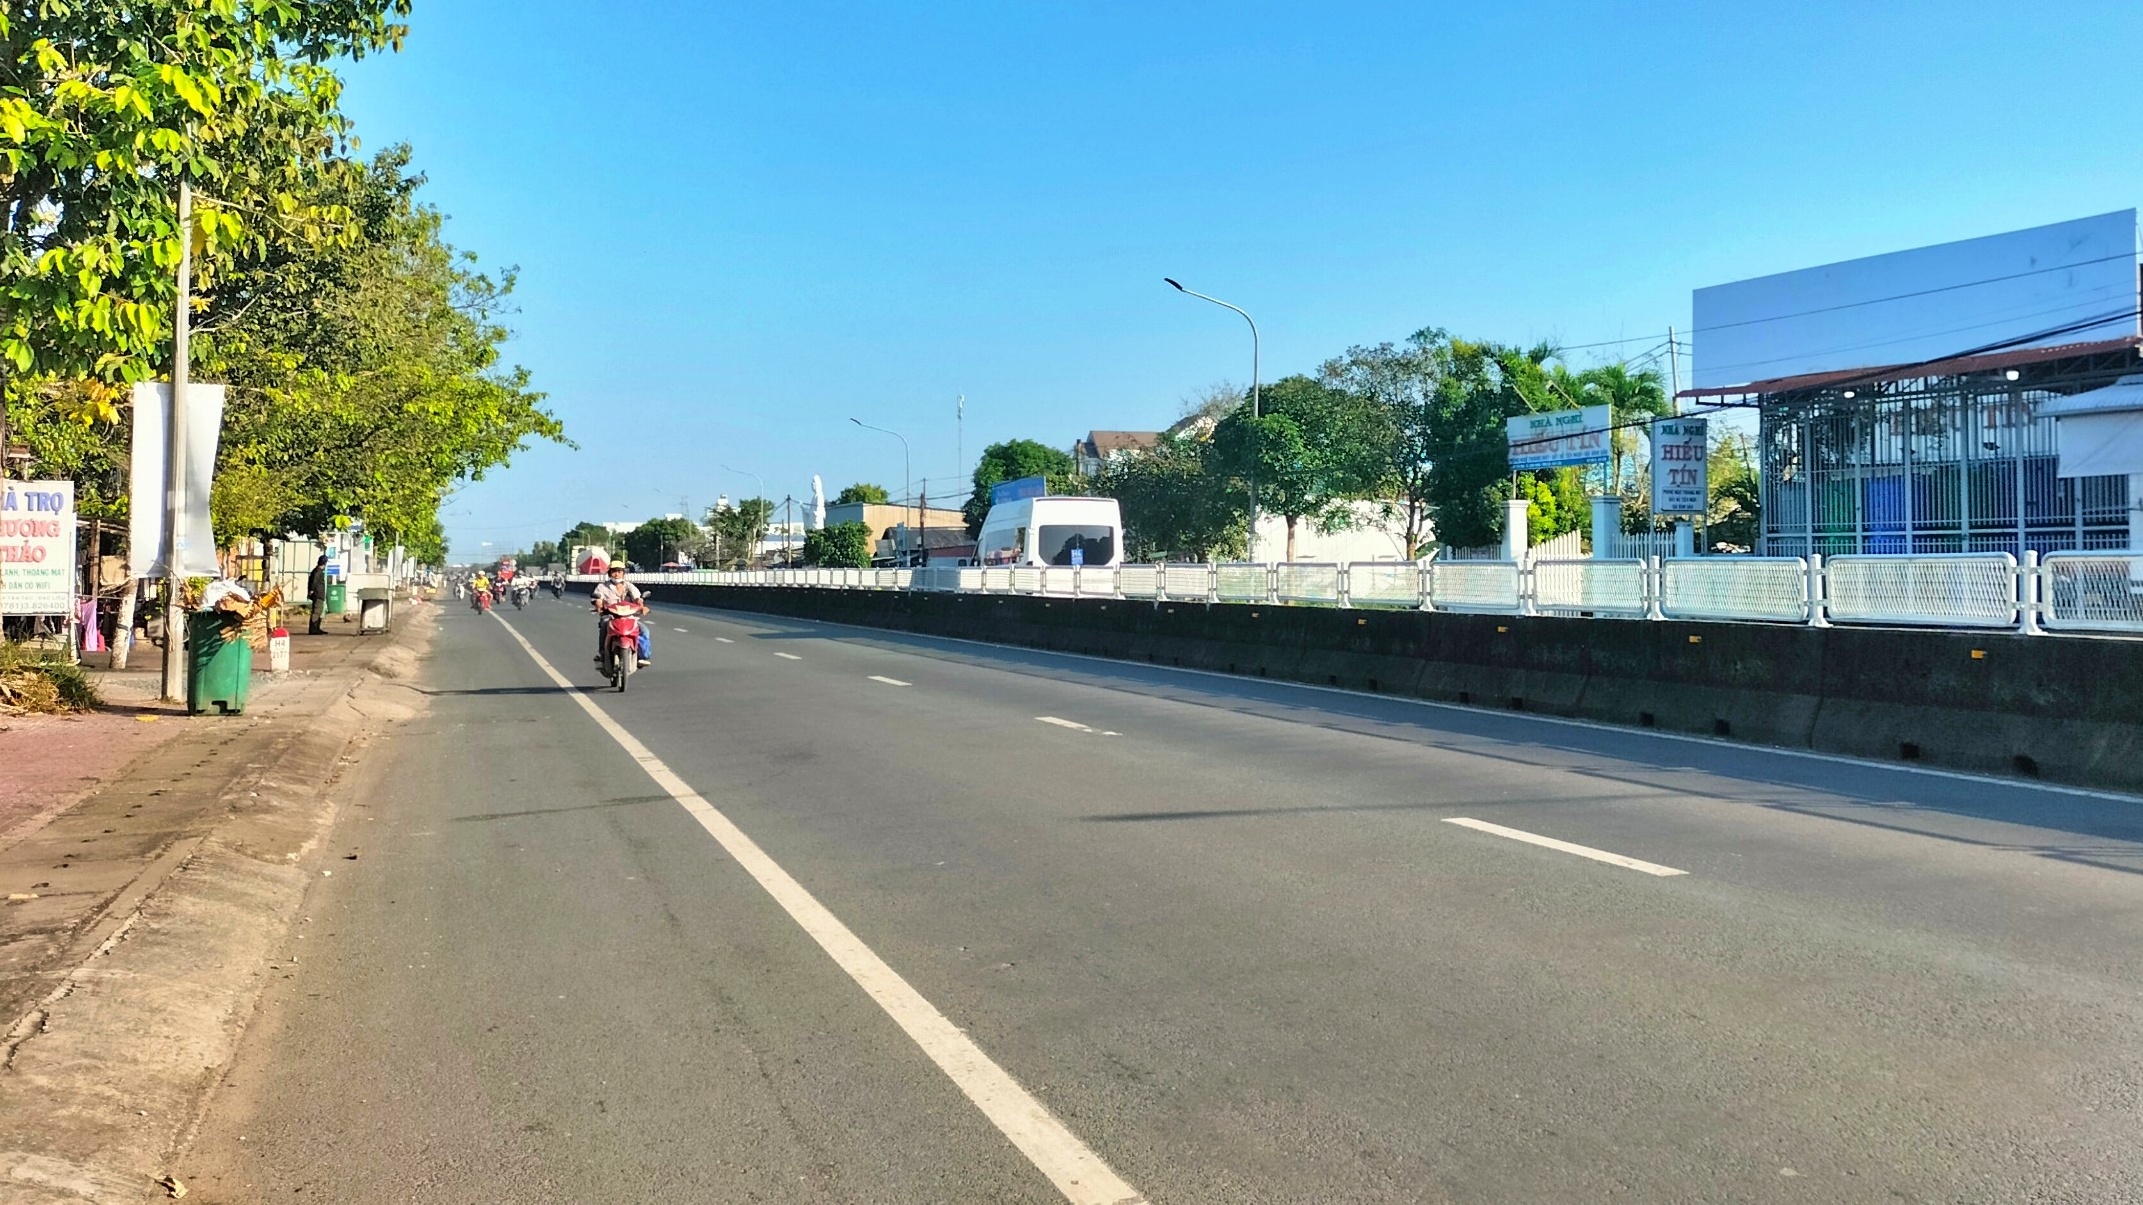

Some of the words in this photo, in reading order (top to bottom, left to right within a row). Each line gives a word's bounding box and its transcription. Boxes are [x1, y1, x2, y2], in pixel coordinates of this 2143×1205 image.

[1529, 416, 1553, 429] NHÀ
[1661, 422, 1680, 436] NHÀ
[1661, 438, 1704, 461] HIẾU
[24, 491, 64, 515] TRỌ
